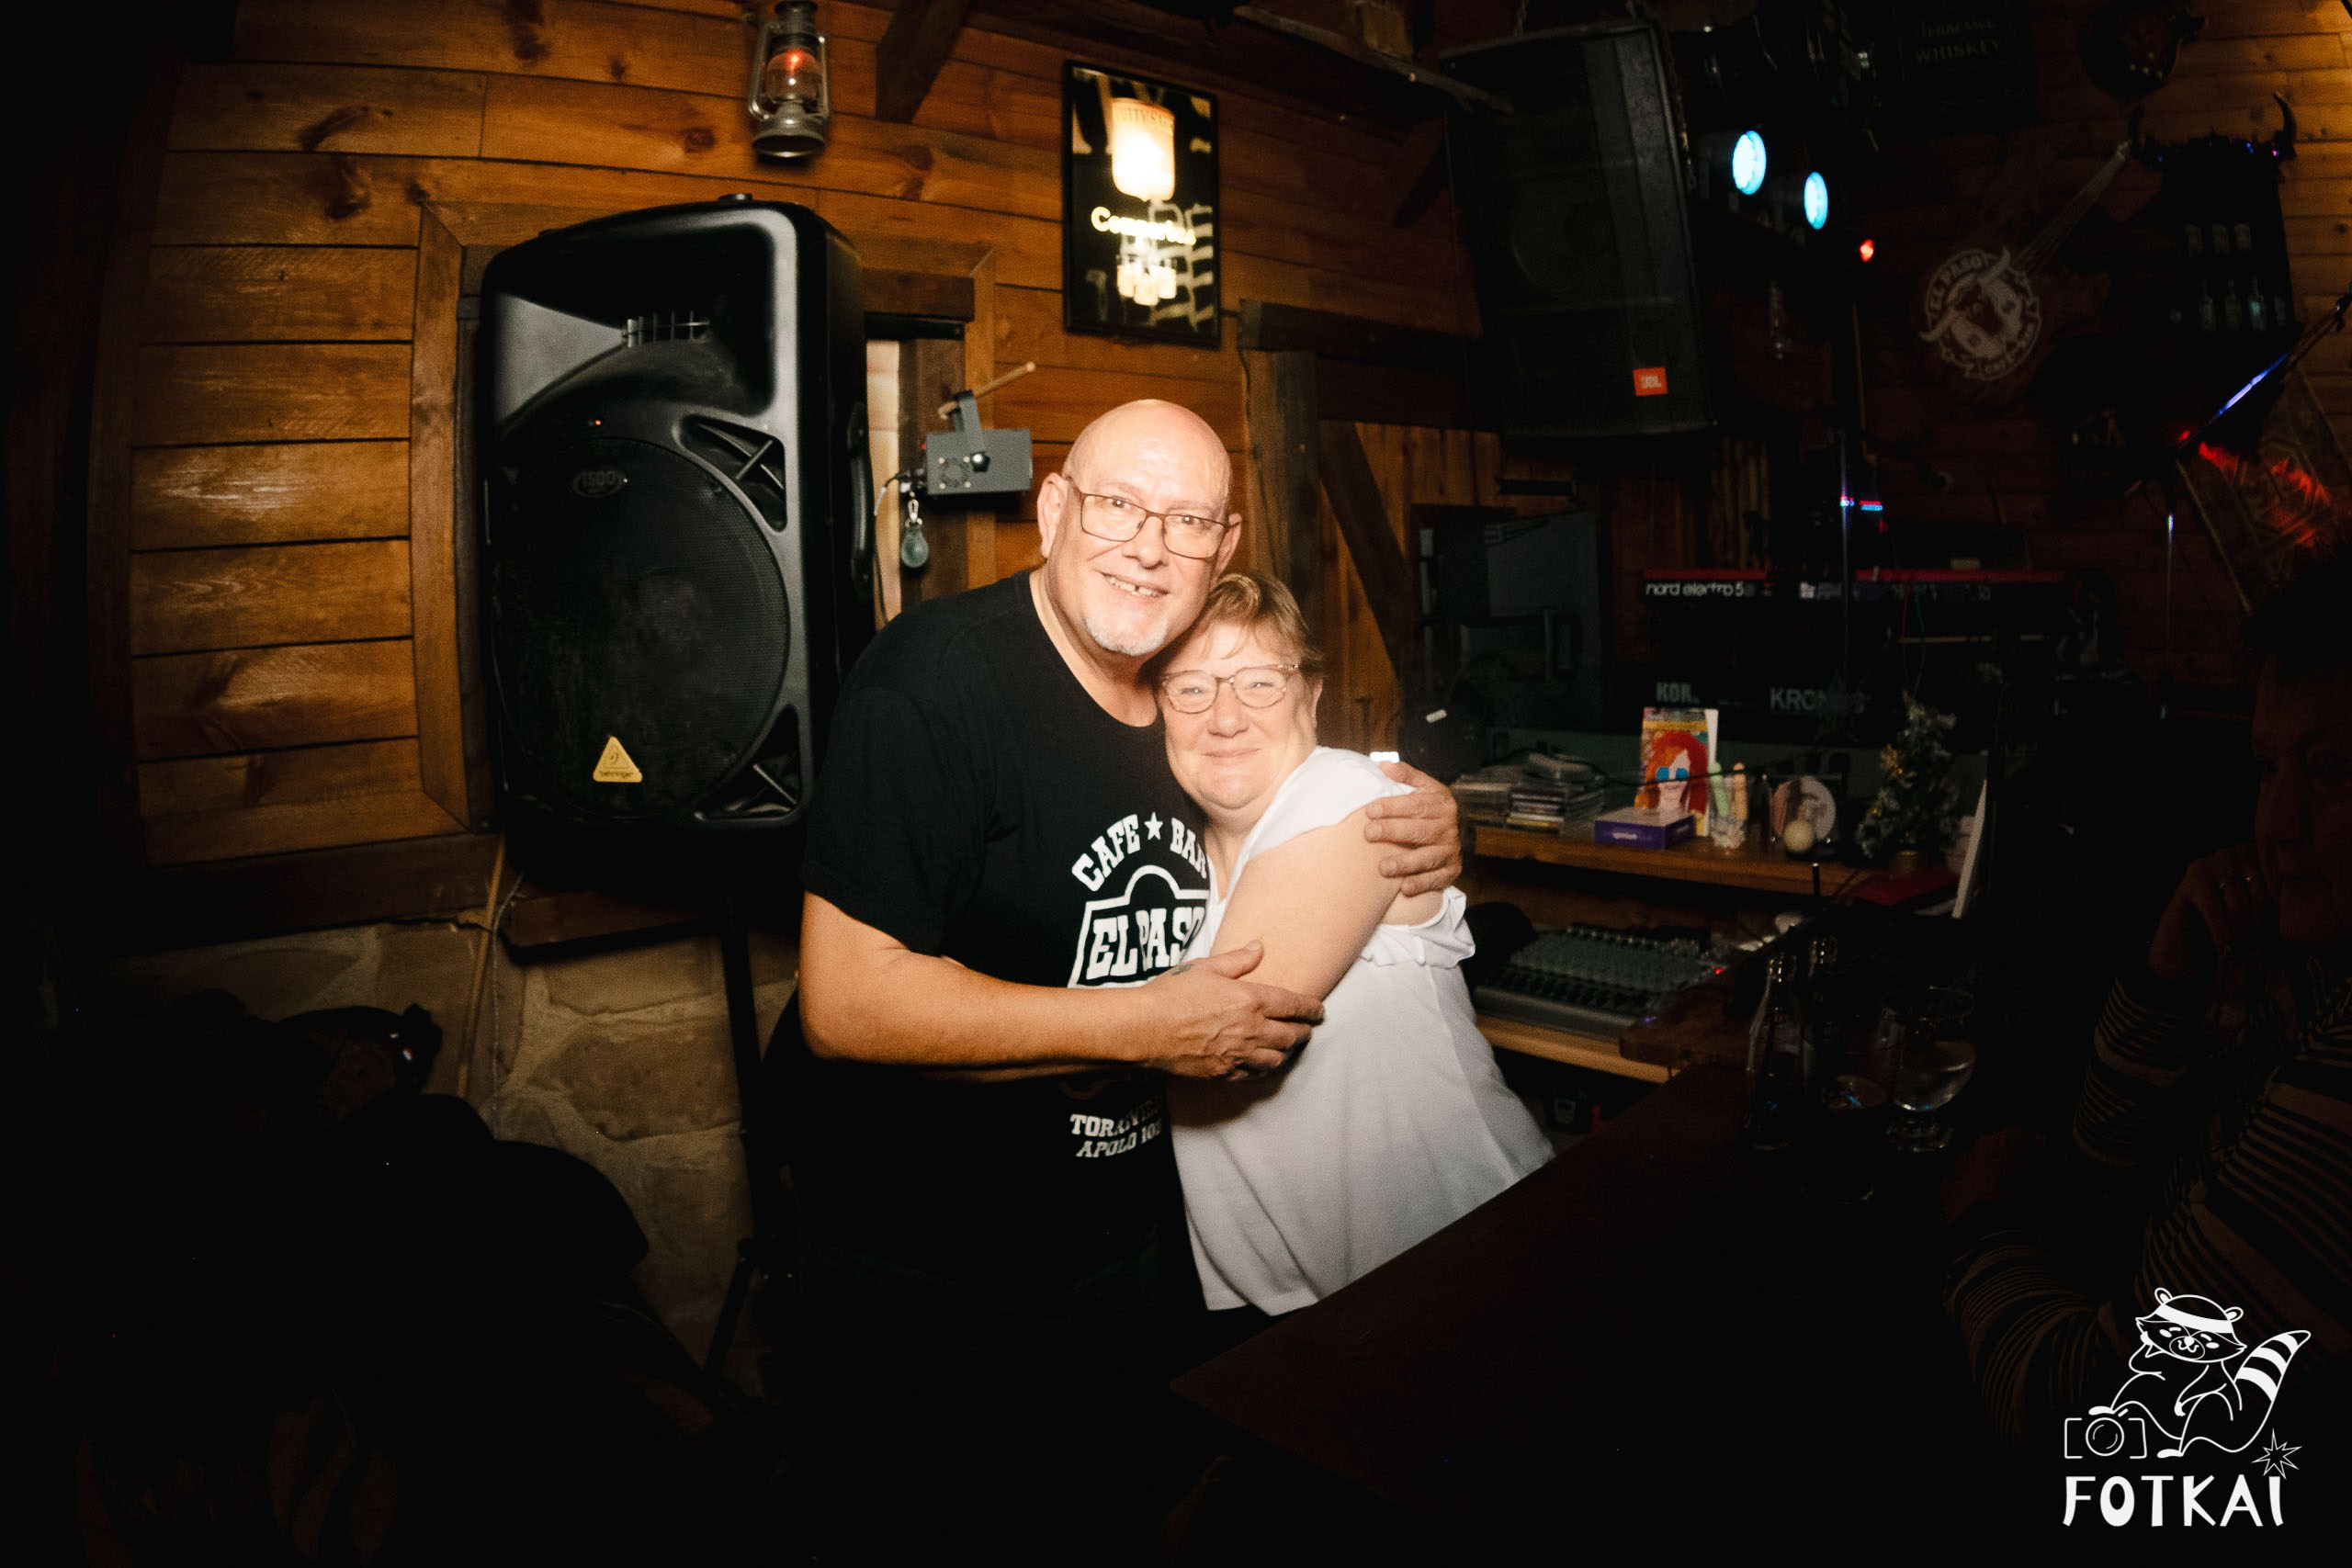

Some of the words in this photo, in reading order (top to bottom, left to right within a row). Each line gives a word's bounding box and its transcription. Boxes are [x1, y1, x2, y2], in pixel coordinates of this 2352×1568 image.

[1645, 581, 1680, 597] nord
[1682, 581, 1735, 597] electro
[1071, 814, 1141, 892] CAFE
[1086, 915, 1138, 980] EL
[1076, 1132, 1137, 1158] APOLO
